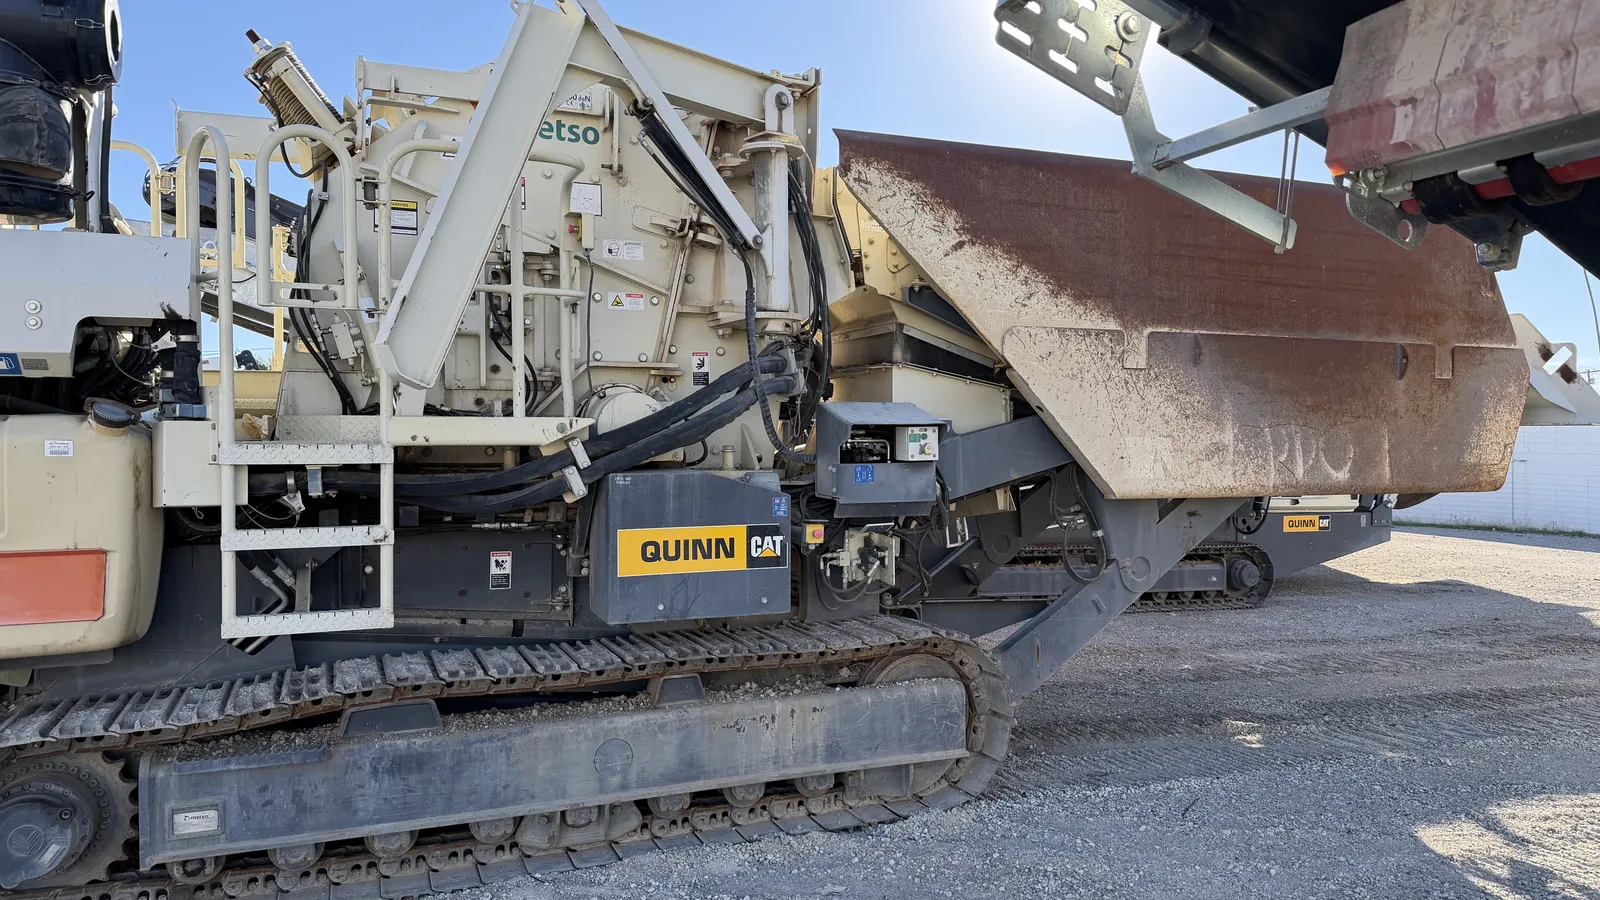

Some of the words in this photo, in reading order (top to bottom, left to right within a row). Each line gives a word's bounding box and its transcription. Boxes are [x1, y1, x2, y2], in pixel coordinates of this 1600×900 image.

[538, 120, 600, 145] etso
[1288, 519, 1315, 528] QUINN
[1320, 519, 1330, 527] CAT
[641, 537, 735, 562] QUINN
[751, 536, 784, 557] CAT
